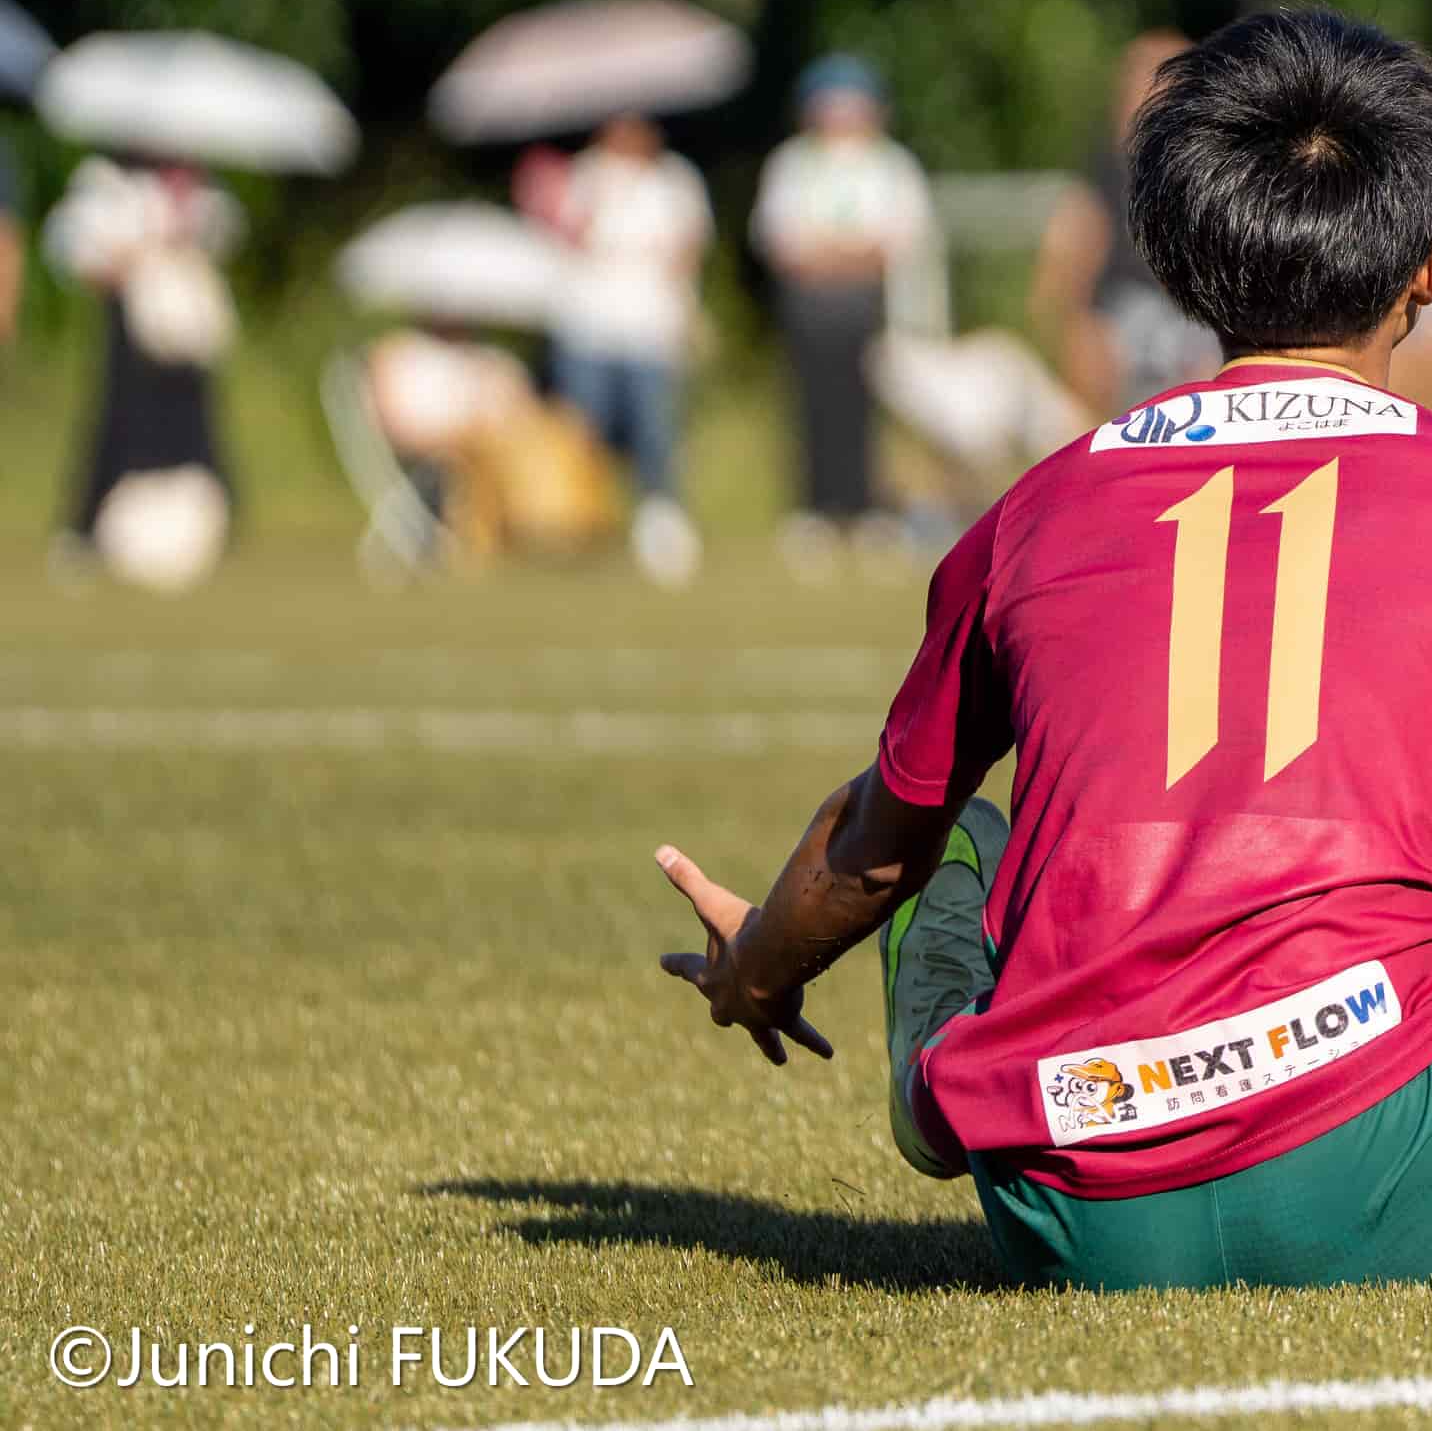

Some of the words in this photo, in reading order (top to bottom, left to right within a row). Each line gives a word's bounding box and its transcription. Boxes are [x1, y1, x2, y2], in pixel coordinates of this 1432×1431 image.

[1224, 391, 1407, 423] KIZUNA
[1154, 456, 1339, 791] 11
[1137, 1037, 1255, 1094] NEXT
[1267, 982, 1388, 1059] FLOW
[1166, 1033, 1374, 1111] 訪問看護ステーシ
